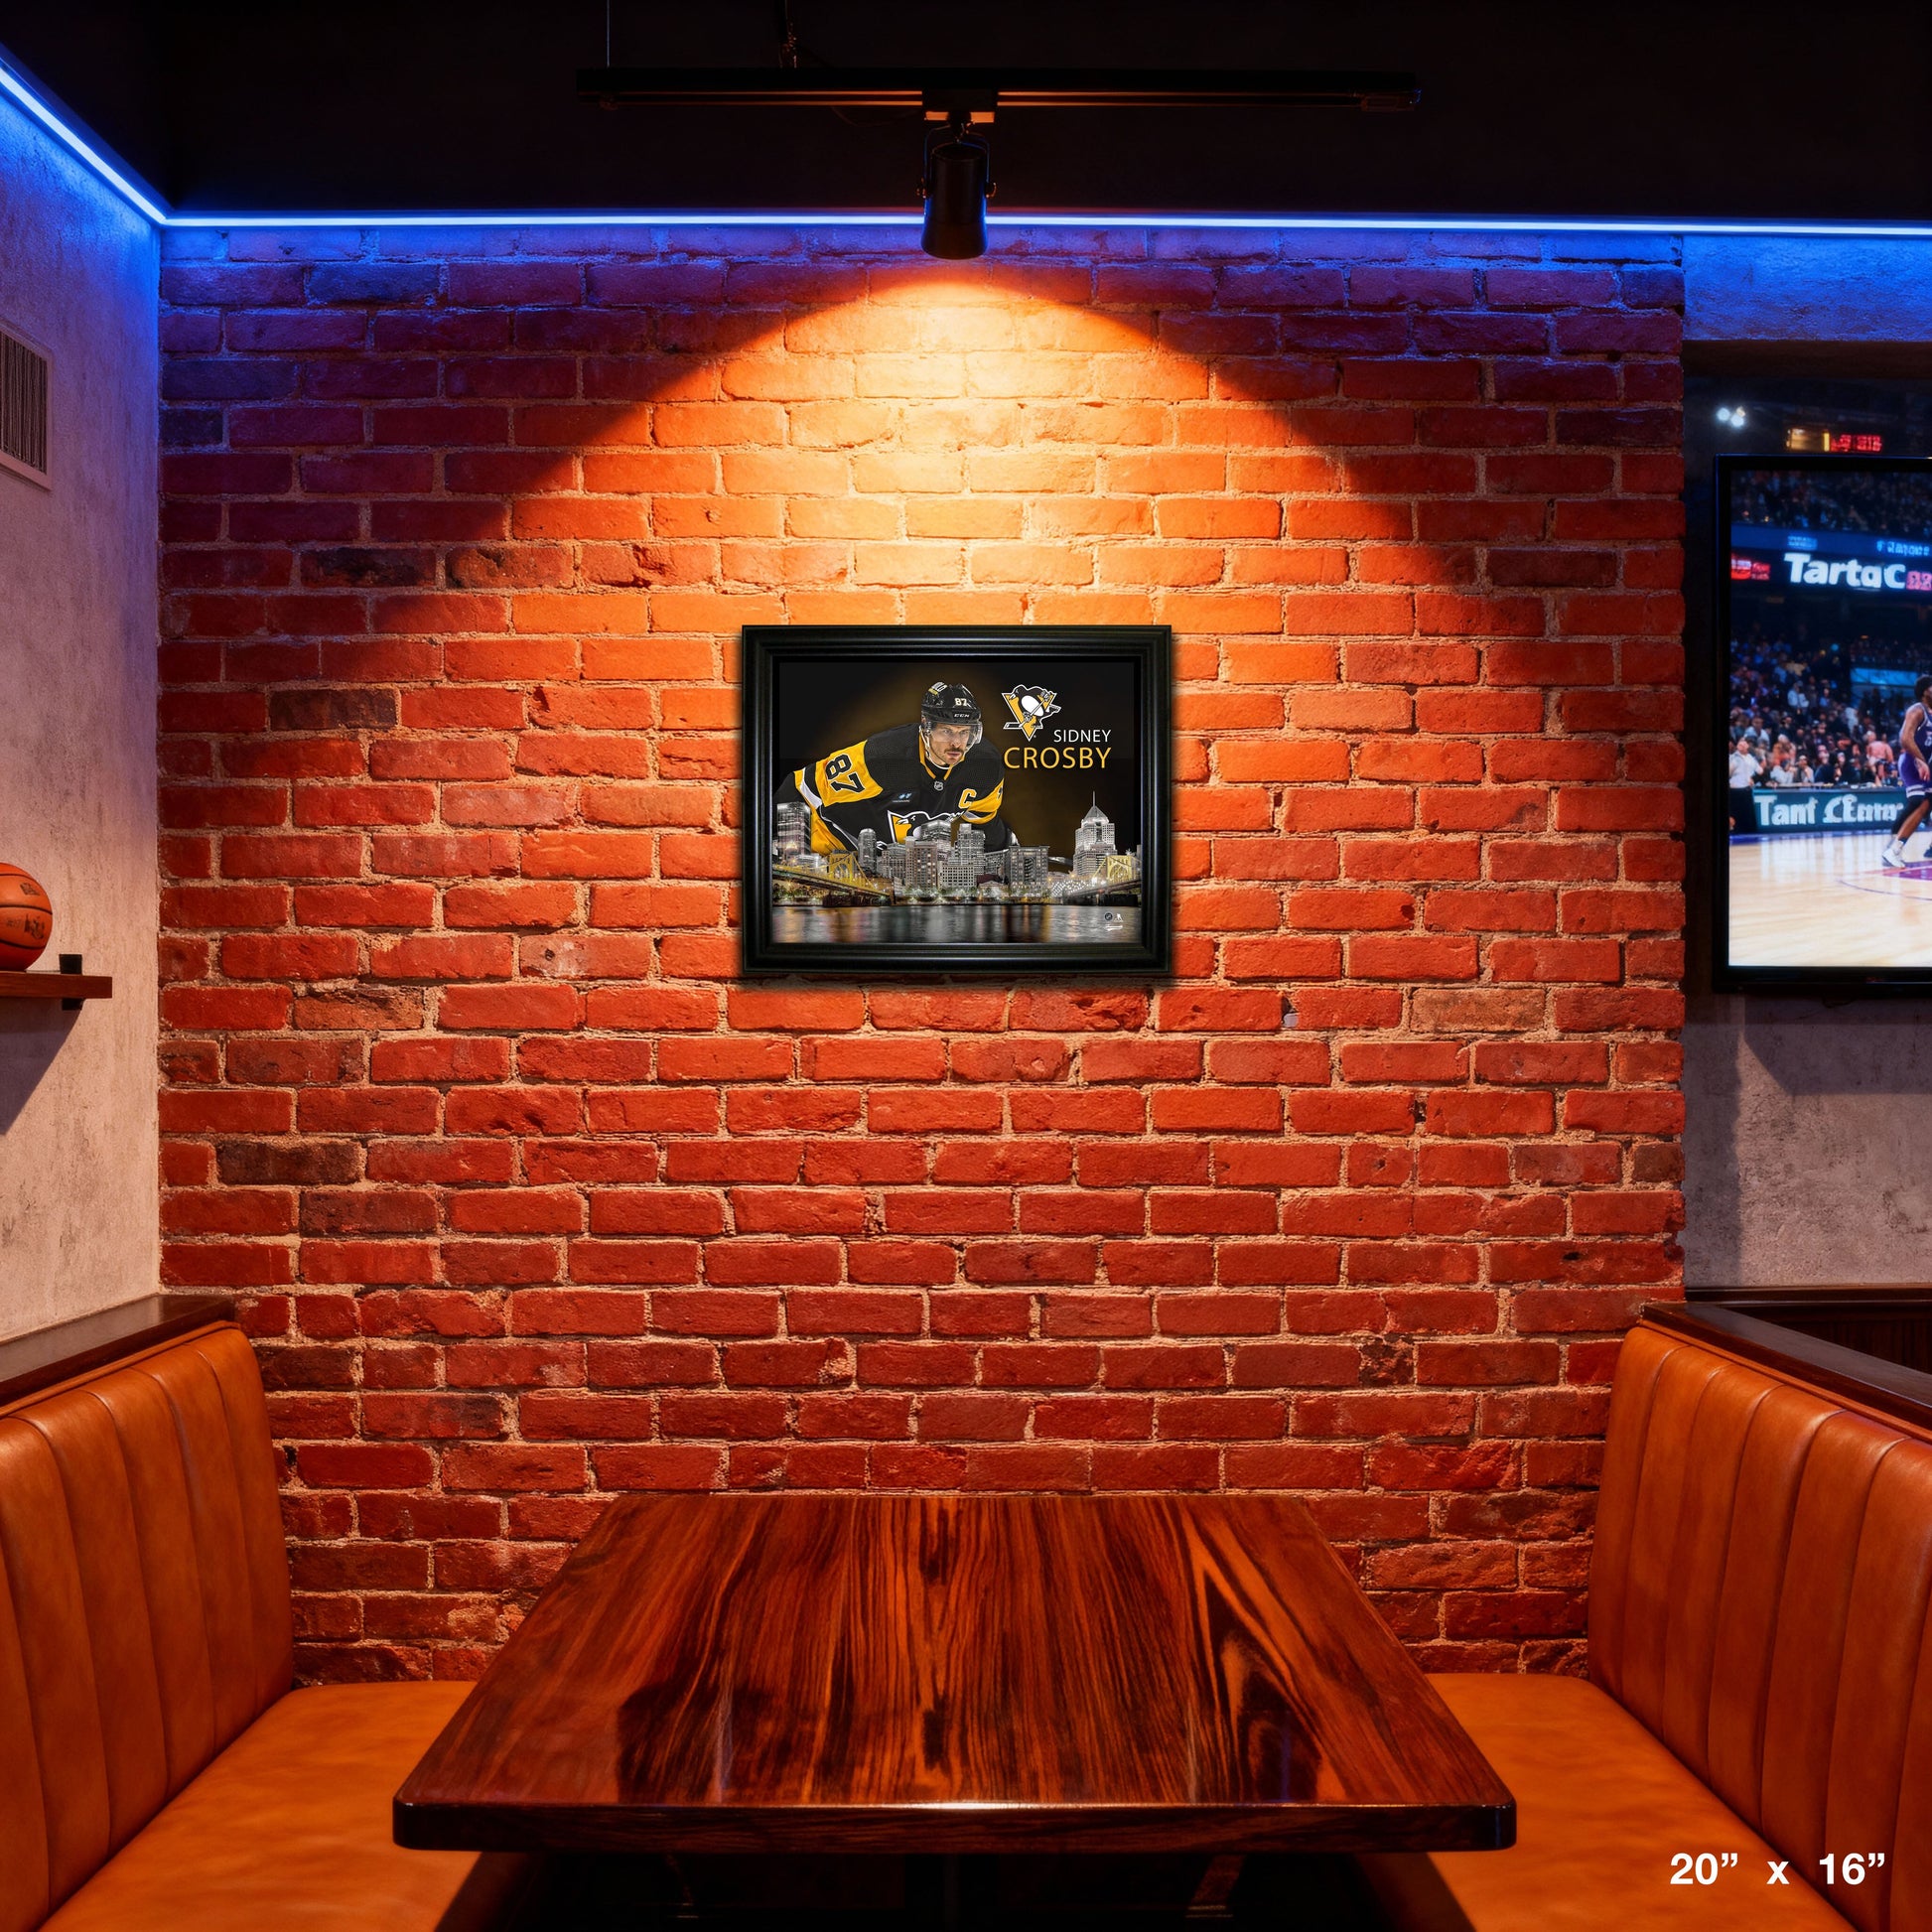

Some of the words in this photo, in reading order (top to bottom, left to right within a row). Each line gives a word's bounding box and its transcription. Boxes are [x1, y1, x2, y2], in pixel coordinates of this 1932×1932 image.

[954, 697, 968, 706] 87
[1053, 729, 1112, 743] SIDNEY
[1003, 747, 1112, 769] CROSBY
[825, 754, 866, 793] 87
[958, 788, 977, 809] C
